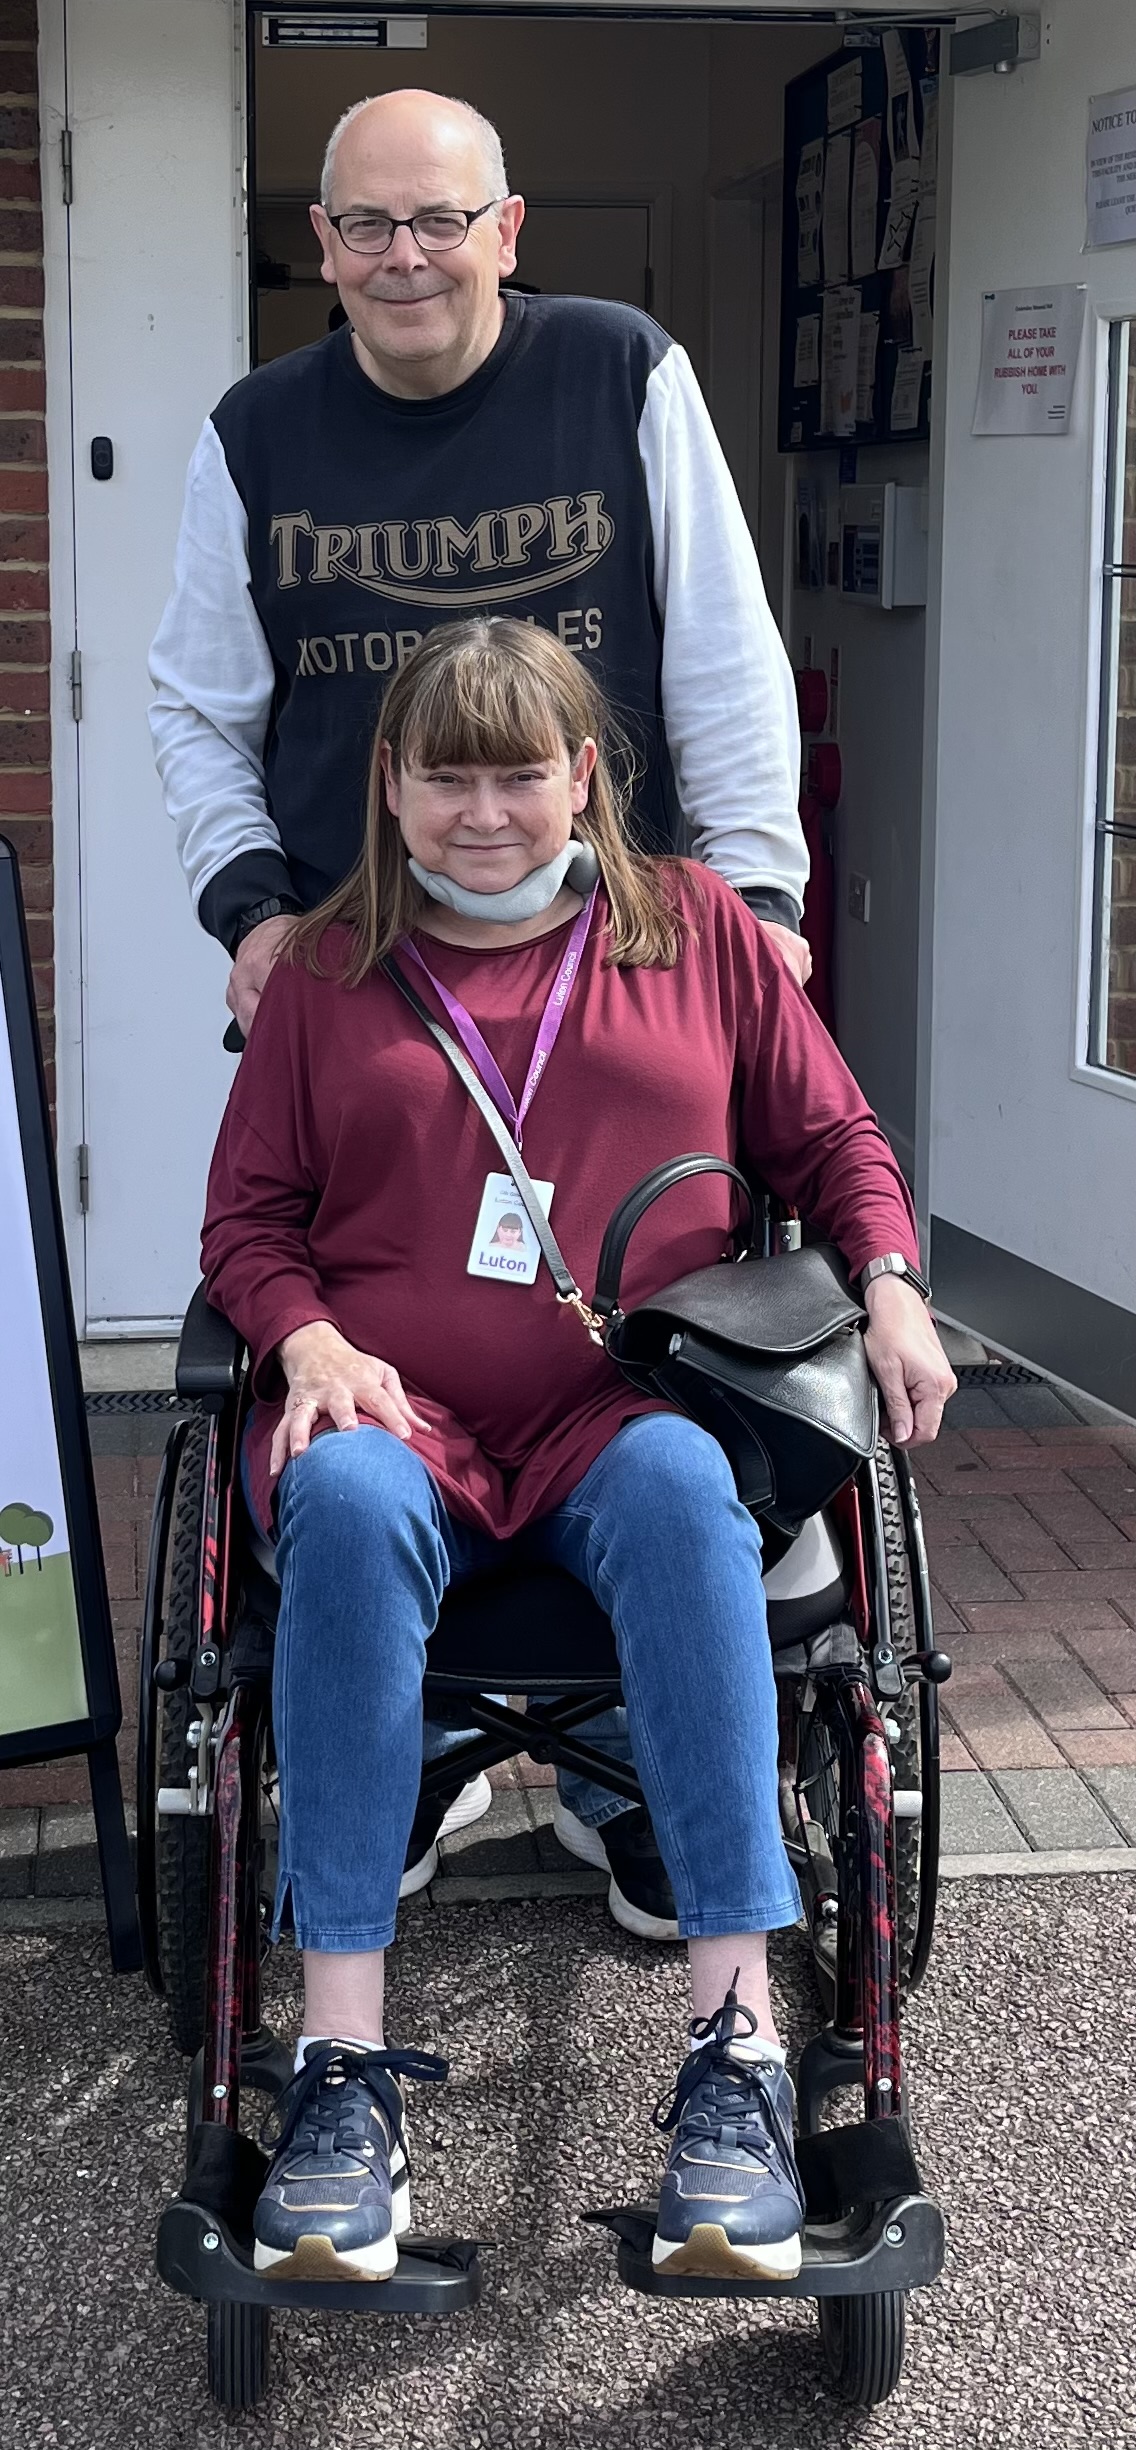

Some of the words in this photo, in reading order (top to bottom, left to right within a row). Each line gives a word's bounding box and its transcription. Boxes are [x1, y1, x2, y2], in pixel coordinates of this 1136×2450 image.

[1092, 112, 1123, 134] NOTICE
[1009, 328, 1037, 340] PLEASE
[1039, 327, 1056, 338] TAKE
[1008, 348, 1022, 359] ALL
[1024, 347, 1034, 358] OF
[1036, 346, 1055, 358] YOUR
[994, 367, 1026, 378] RUBBISH
[1028, 365, 1047, 376] HOME
[1049, 364, 1066, 376] WITH
[269, 490, 615, 606] TRIUMPH
[552, 982, 569, 1006] Luton
[561, 951, 577, 982] Council
[529, 1049, 547, 1086] Council
[479, 1252, 527, 1272] Luton
